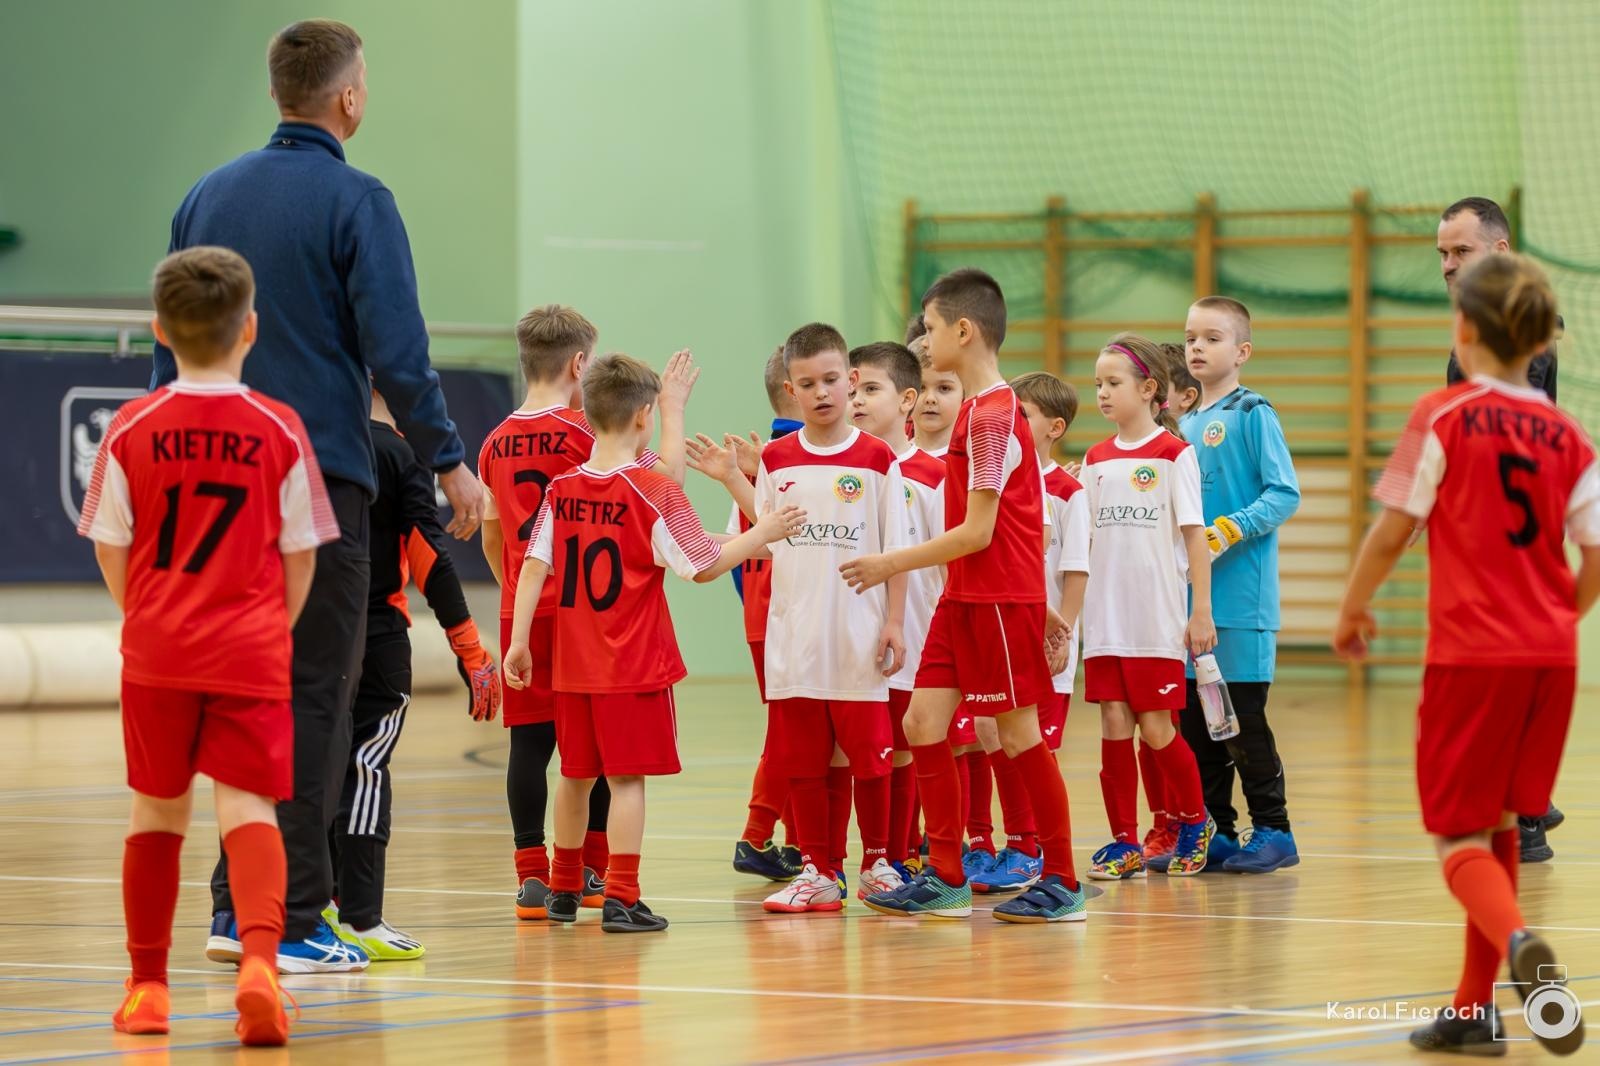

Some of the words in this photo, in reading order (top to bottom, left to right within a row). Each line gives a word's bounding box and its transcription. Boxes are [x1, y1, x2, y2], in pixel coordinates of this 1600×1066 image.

[151, 428, 264, 467] KIETRZ
[491, 432, 568, 460] KIETRZ
[1462, 406, 1567, 452] KIETRZ
[555, 497, 628, 527] KIETRZ
[1095, 505, 1159, 528] EKPOL
[1498, 453, 1540, 548] 5
[151, 481, 248, 574] 17
[560, 534, 624, 612] 10
